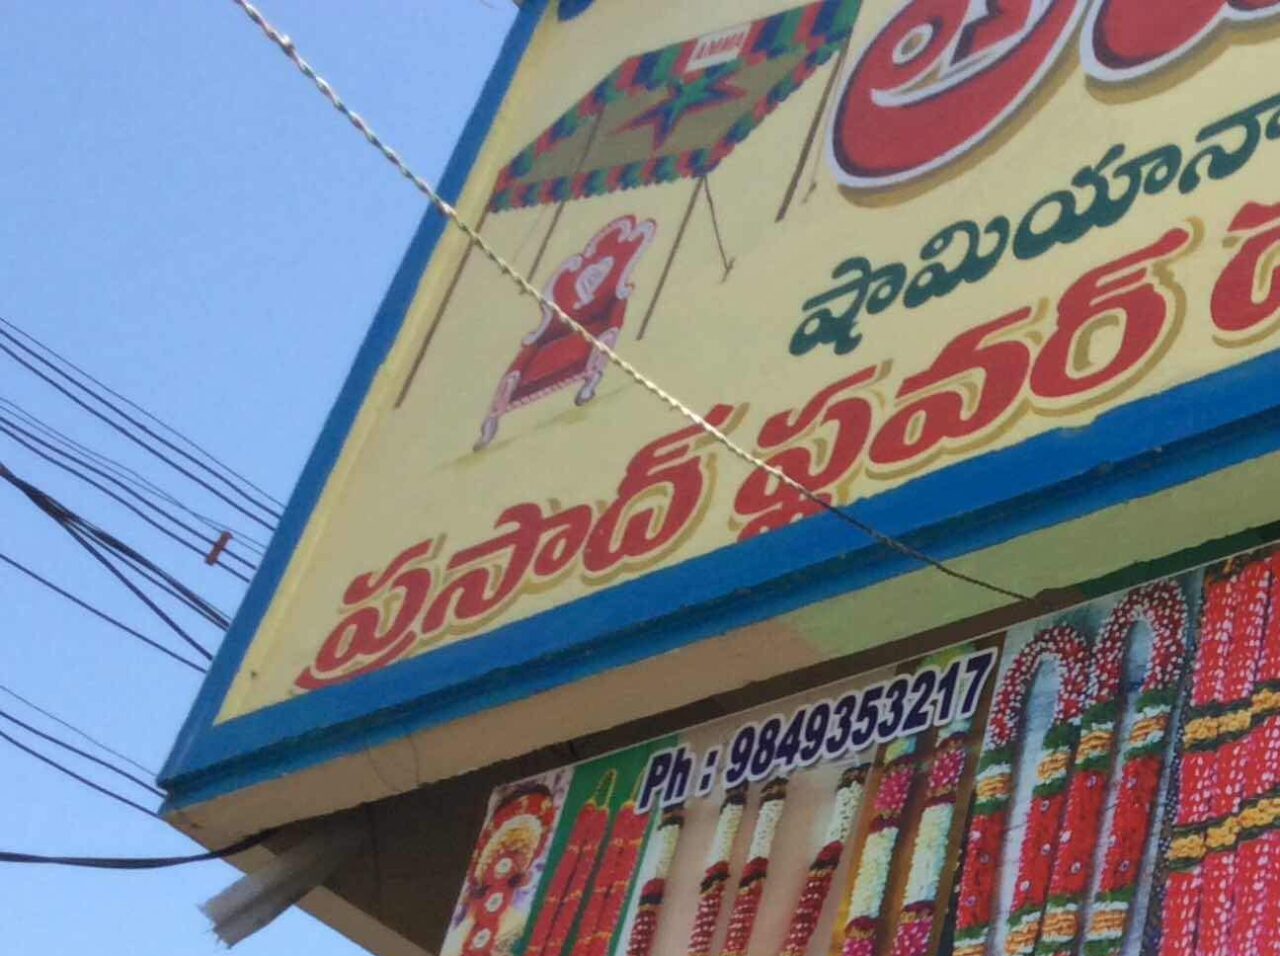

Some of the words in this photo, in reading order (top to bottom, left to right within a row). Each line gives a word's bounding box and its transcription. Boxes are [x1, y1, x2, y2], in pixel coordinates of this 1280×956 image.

[295, 403, 733, 691] ప్రసాద్
[638, 746, 694, 812] Ph
[725, 651, 996, 785] 9849353217
